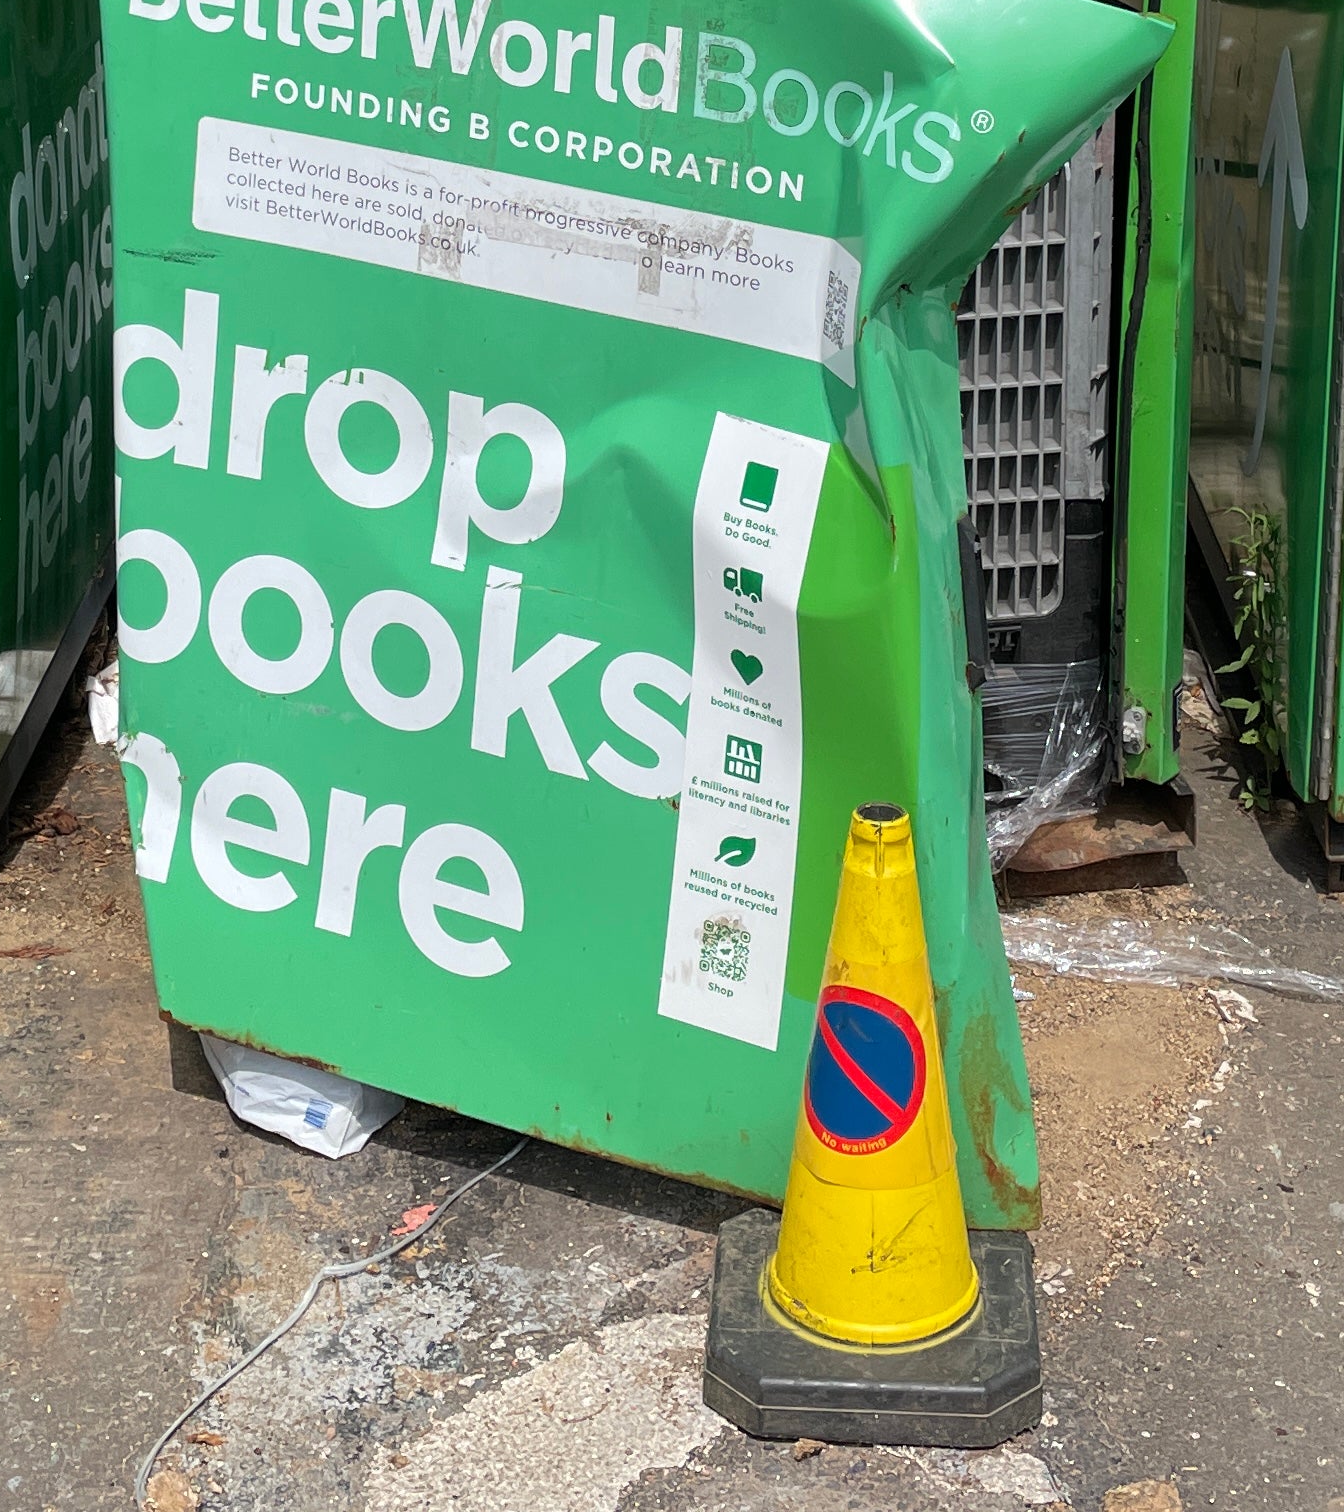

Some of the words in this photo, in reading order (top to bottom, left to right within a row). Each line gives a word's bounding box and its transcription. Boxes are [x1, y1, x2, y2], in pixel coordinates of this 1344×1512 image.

[250, 72, 452, 136] FOUNDING
[469, 116, 491, 140] B
[507, 120, 806, 202] CORPORATION
[226, 194, 260, 212] visit
[227, 171, 306, 198] collected
[312, 184, 350, 206] here
[354, 197, 382, 213] are
[387, 202, 427, 224] sold,
[229, 147, 283, 170] Better
[288, 157, 341, 181] World
[347, 168, 399, 193] Books
[405, 178, 418, 196] is
[423, 186, 433, 200] a
[439, 186, 520, 218] for-profit
[736, 247, 794, 273] Books
[660, 260, 705, 279] learn
[712, 271, 761, 291] more
[16, 205, 113, 462] books
[113, 288, 567, 572] drop
[17, 395, 93, 622] here
[723, 512, 743, 527] Buy
[745, 517, 779, 537] Books.
[725, 527, 739, 539] Do
[742, 532, 772, 549] Good.
[724, 611, 766, 635] Shipping!
[734, 604, 754, 618] Free
[710, 697, 741, 716] books
[743, 706, 783, 728] donated
[723, 687, 760, 708] Millions
[762, 699, 772, 711] of
[688, 788, 726, 808] literacy
[728, 801, 747, 813] and
[750, 806, 791, 826] libraries
[691, 776, 698, 786] £
[700, 779, 740, 797] millions
[742, 790, 773, 809] raised
[775, 800, 790, 813] for
[684, 880, 718, 899] reused
[721, 892, 731, 902] or
[734, 894, 778, 916] recycled
[690, 868, 728, 888] Millions
[731, 880, 742, 890] of
[744, 886, 775, 902] books
[708, 982, 734, 998] Shop
[821, 1132, 837, 1147] No
[842, 1138, 887, 1152] waiting
